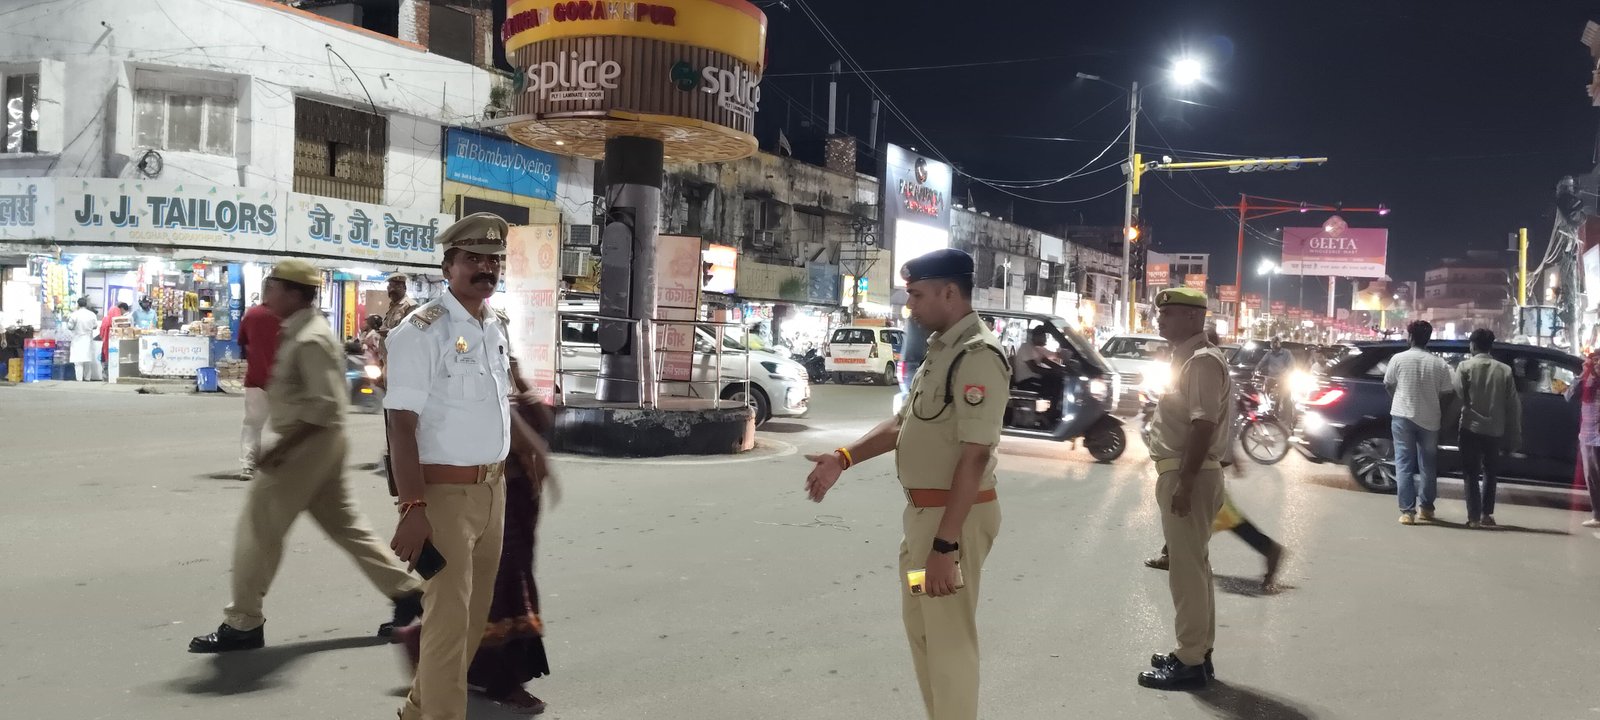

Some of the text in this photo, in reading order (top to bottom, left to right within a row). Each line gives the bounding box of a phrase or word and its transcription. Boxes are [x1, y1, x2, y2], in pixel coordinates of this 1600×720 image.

[553, 1, 676, 26] GORAKHPUR
[527, 50, 621, 99] splice
[701, 65, 760, 112] splice
[469, 143, 552, 182] Bombay Dyeing
[74, 194, 277, 236] J. J. TAILORS
[308, 203, 440, 252] जे. जे. टेलर्स
[1309, 237, 1358, 250] GEETA
